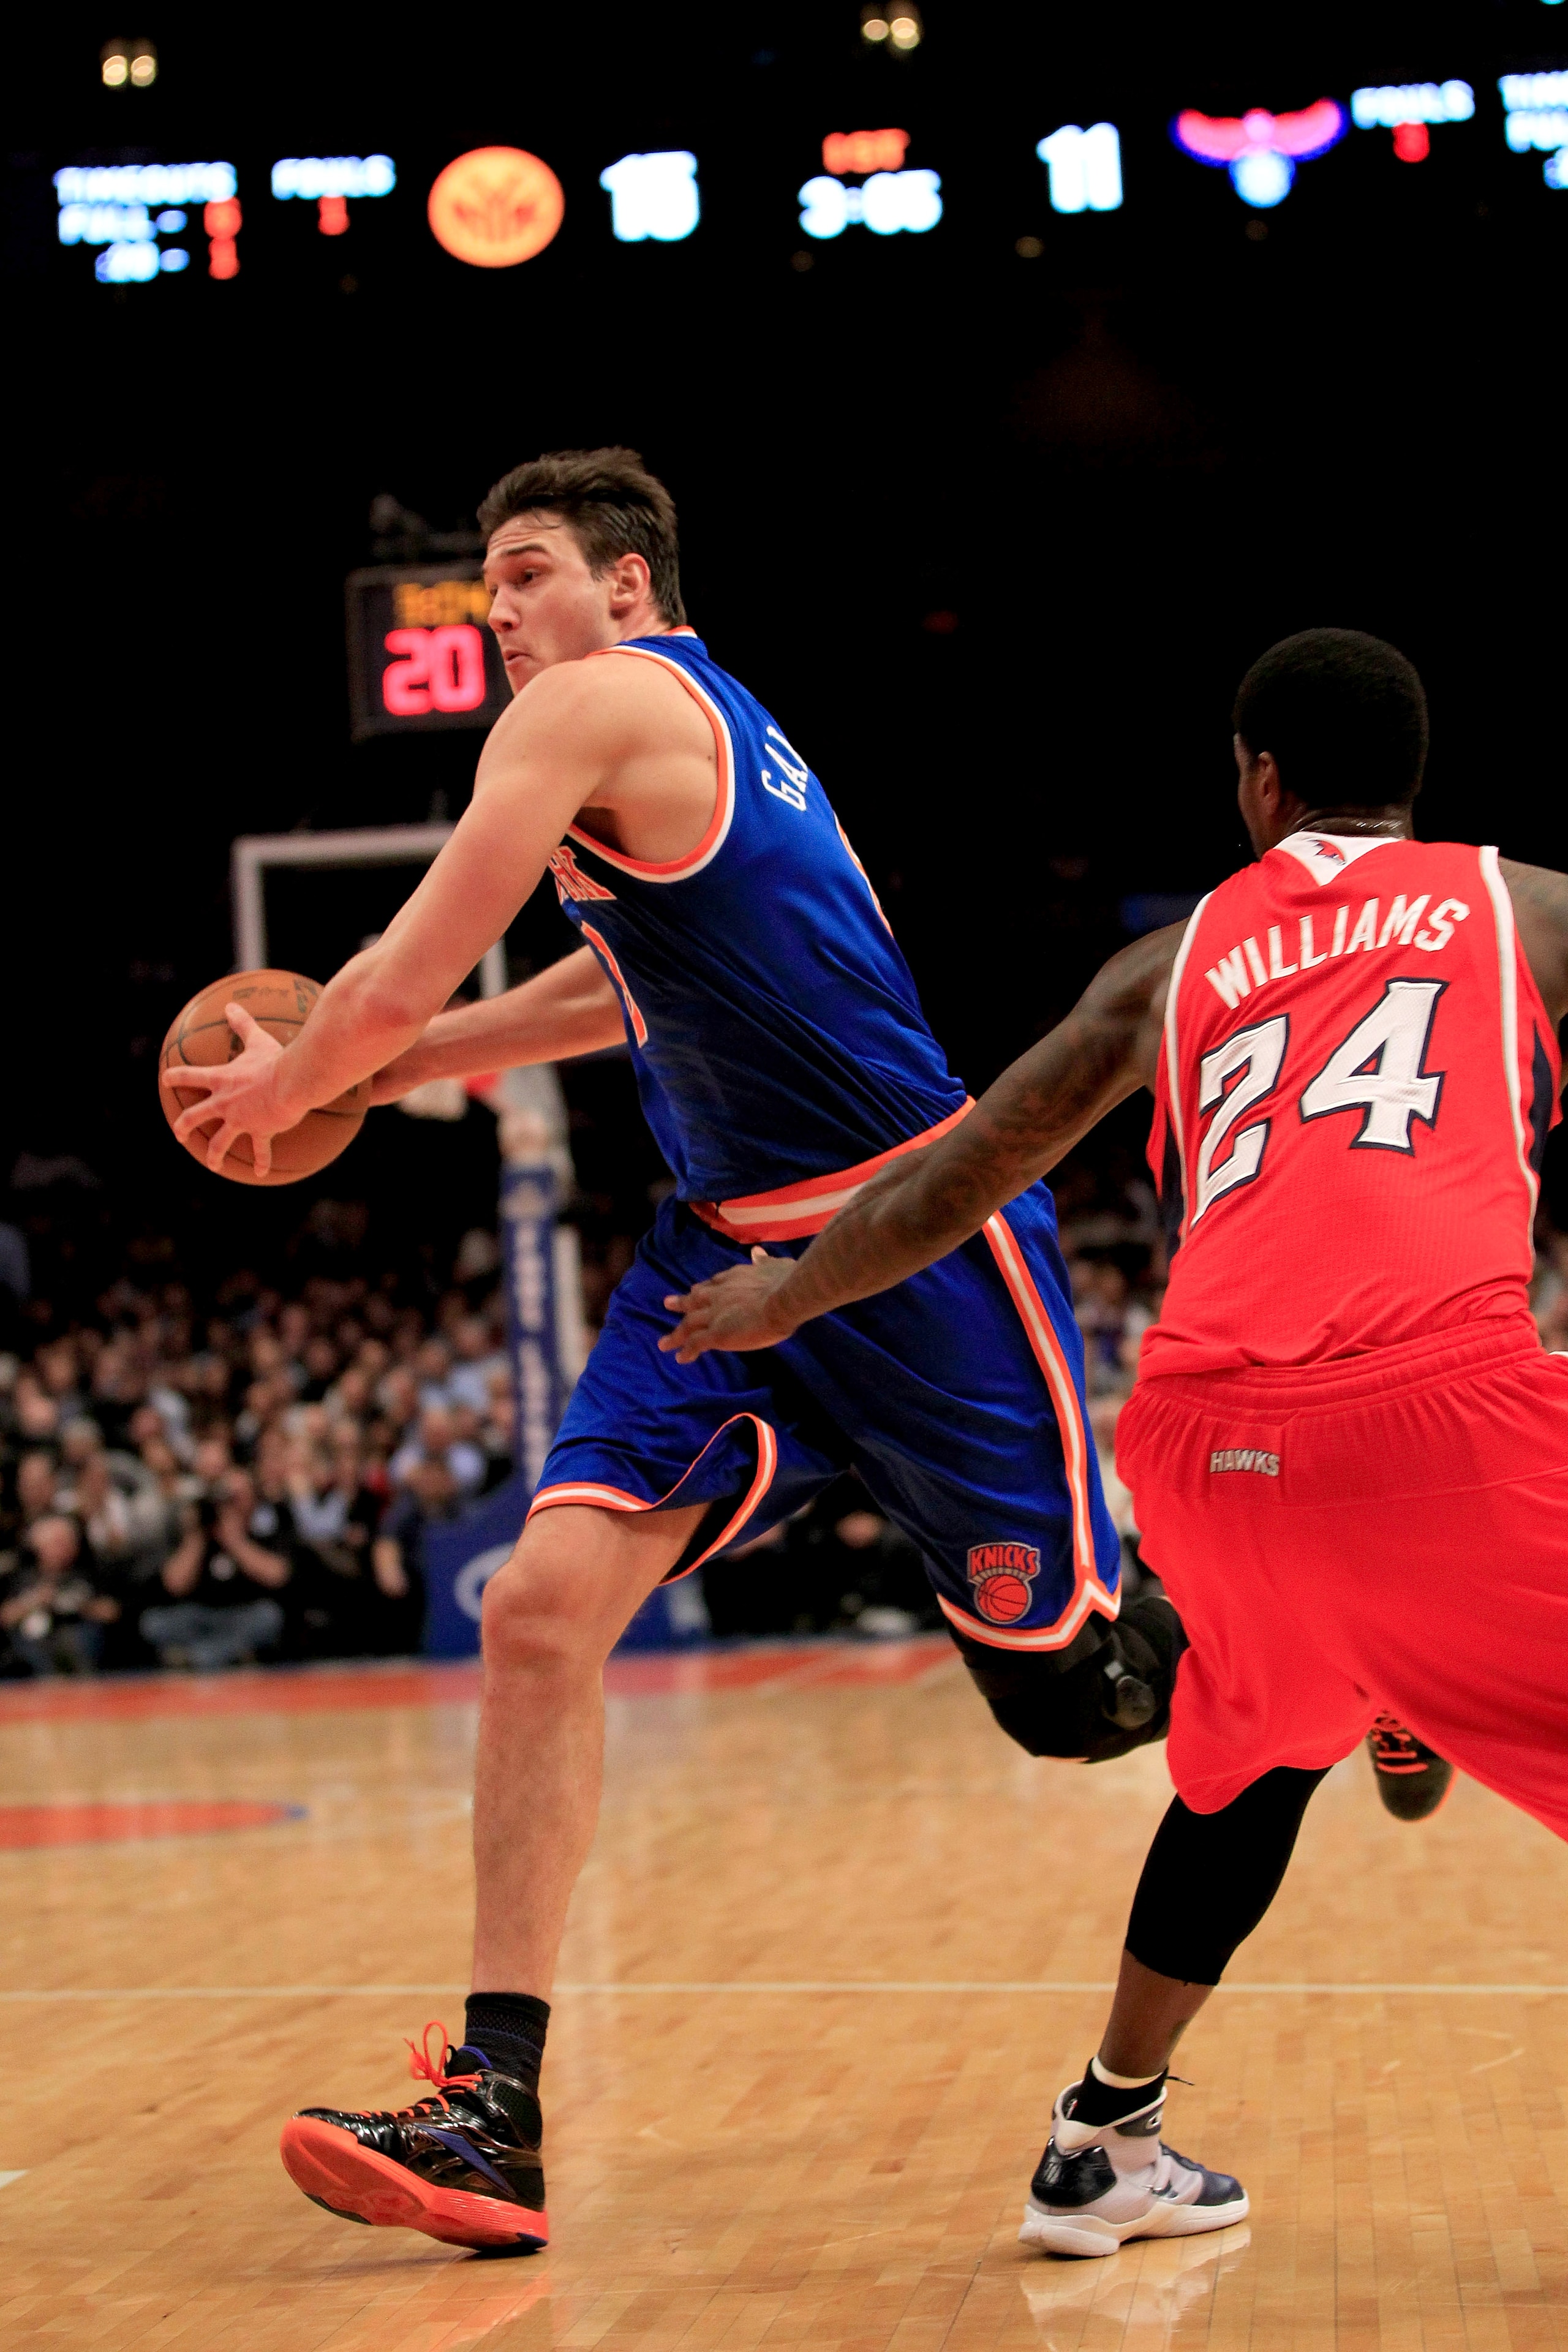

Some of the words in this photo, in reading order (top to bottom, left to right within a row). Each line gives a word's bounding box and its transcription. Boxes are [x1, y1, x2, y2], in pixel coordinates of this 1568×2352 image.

[382, 624, 486, 716] 20
[1204, 894, 1471, 1011] WILLIAMS
[1189, 976, 1450, 1232] 24
[1210, 1449, 1280, 1476] HAWKS
[969, 1545, 1038, 1577] KNICKS
